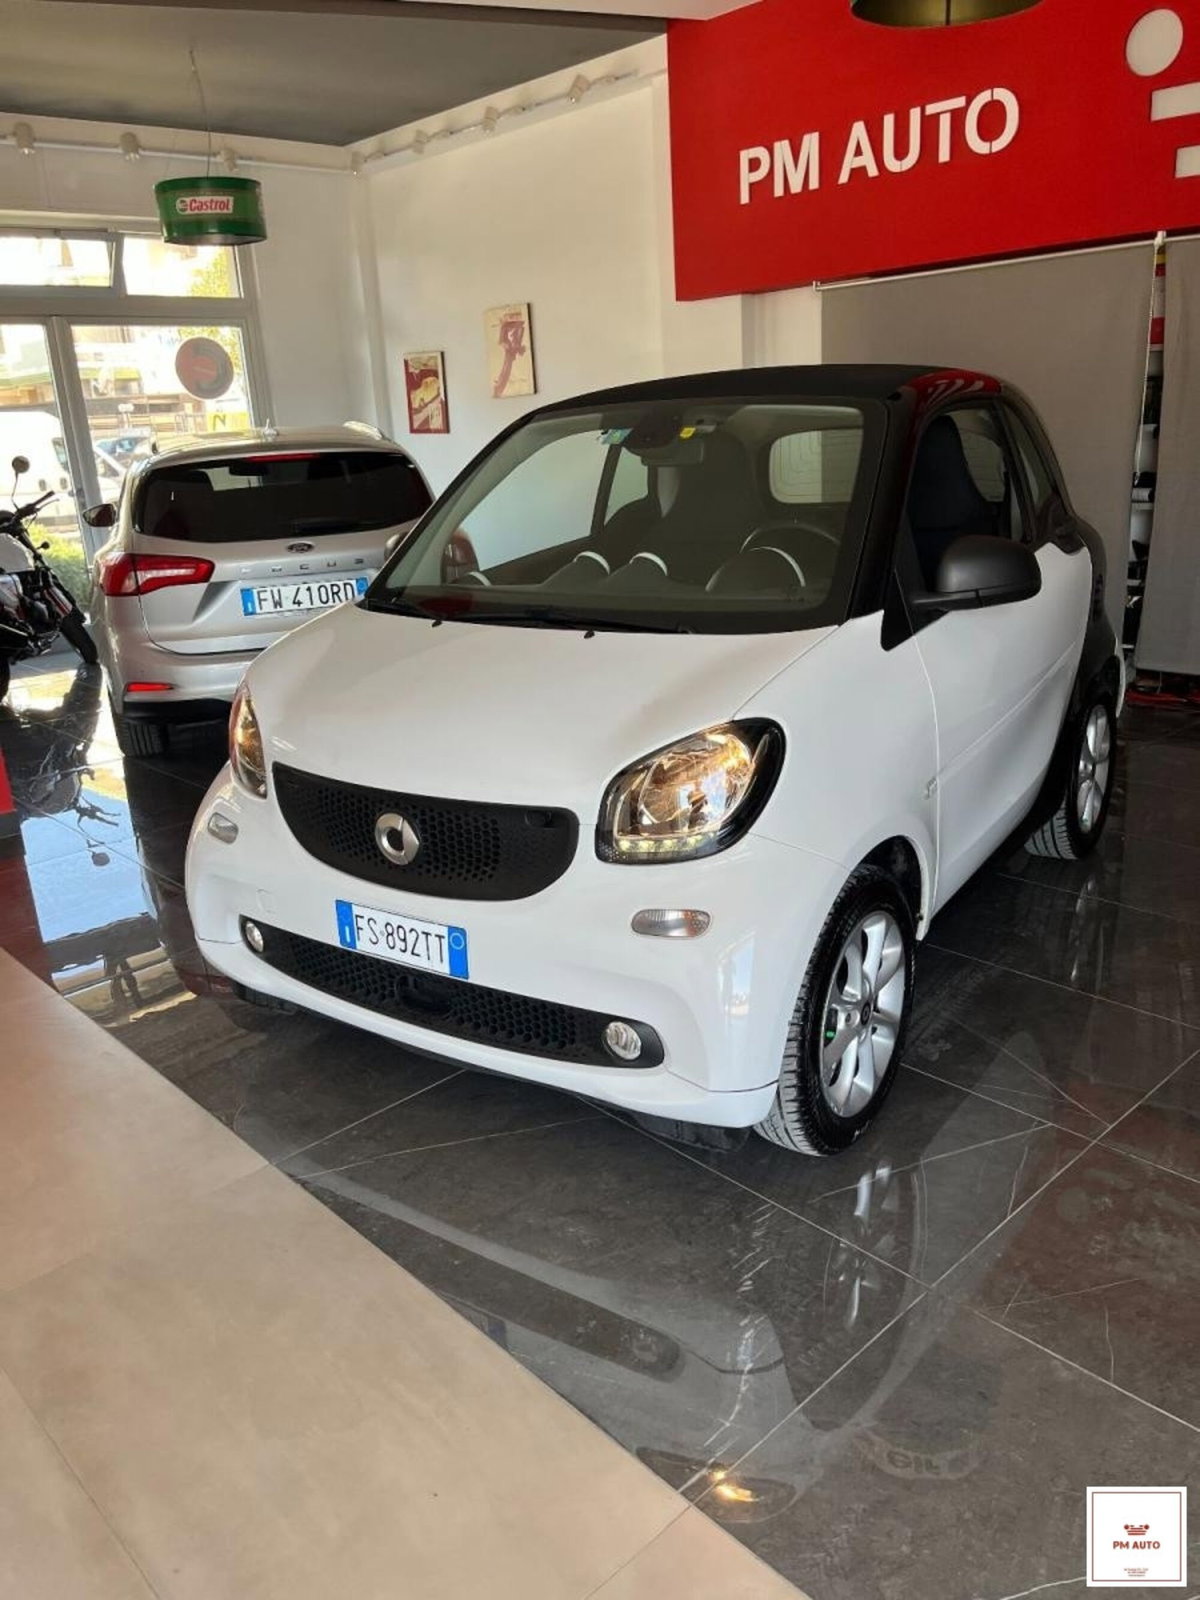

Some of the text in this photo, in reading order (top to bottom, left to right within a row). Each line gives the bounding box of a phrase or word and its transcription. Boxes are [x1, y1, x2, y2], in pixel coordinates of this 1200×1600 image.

[739, 87, 1020, 205] PM AUTO
[189, 198, 230, 212] Castrol
[256, 582, 356, 611] FW 410RD
[354, 914, 446, 964] FS 892TT
